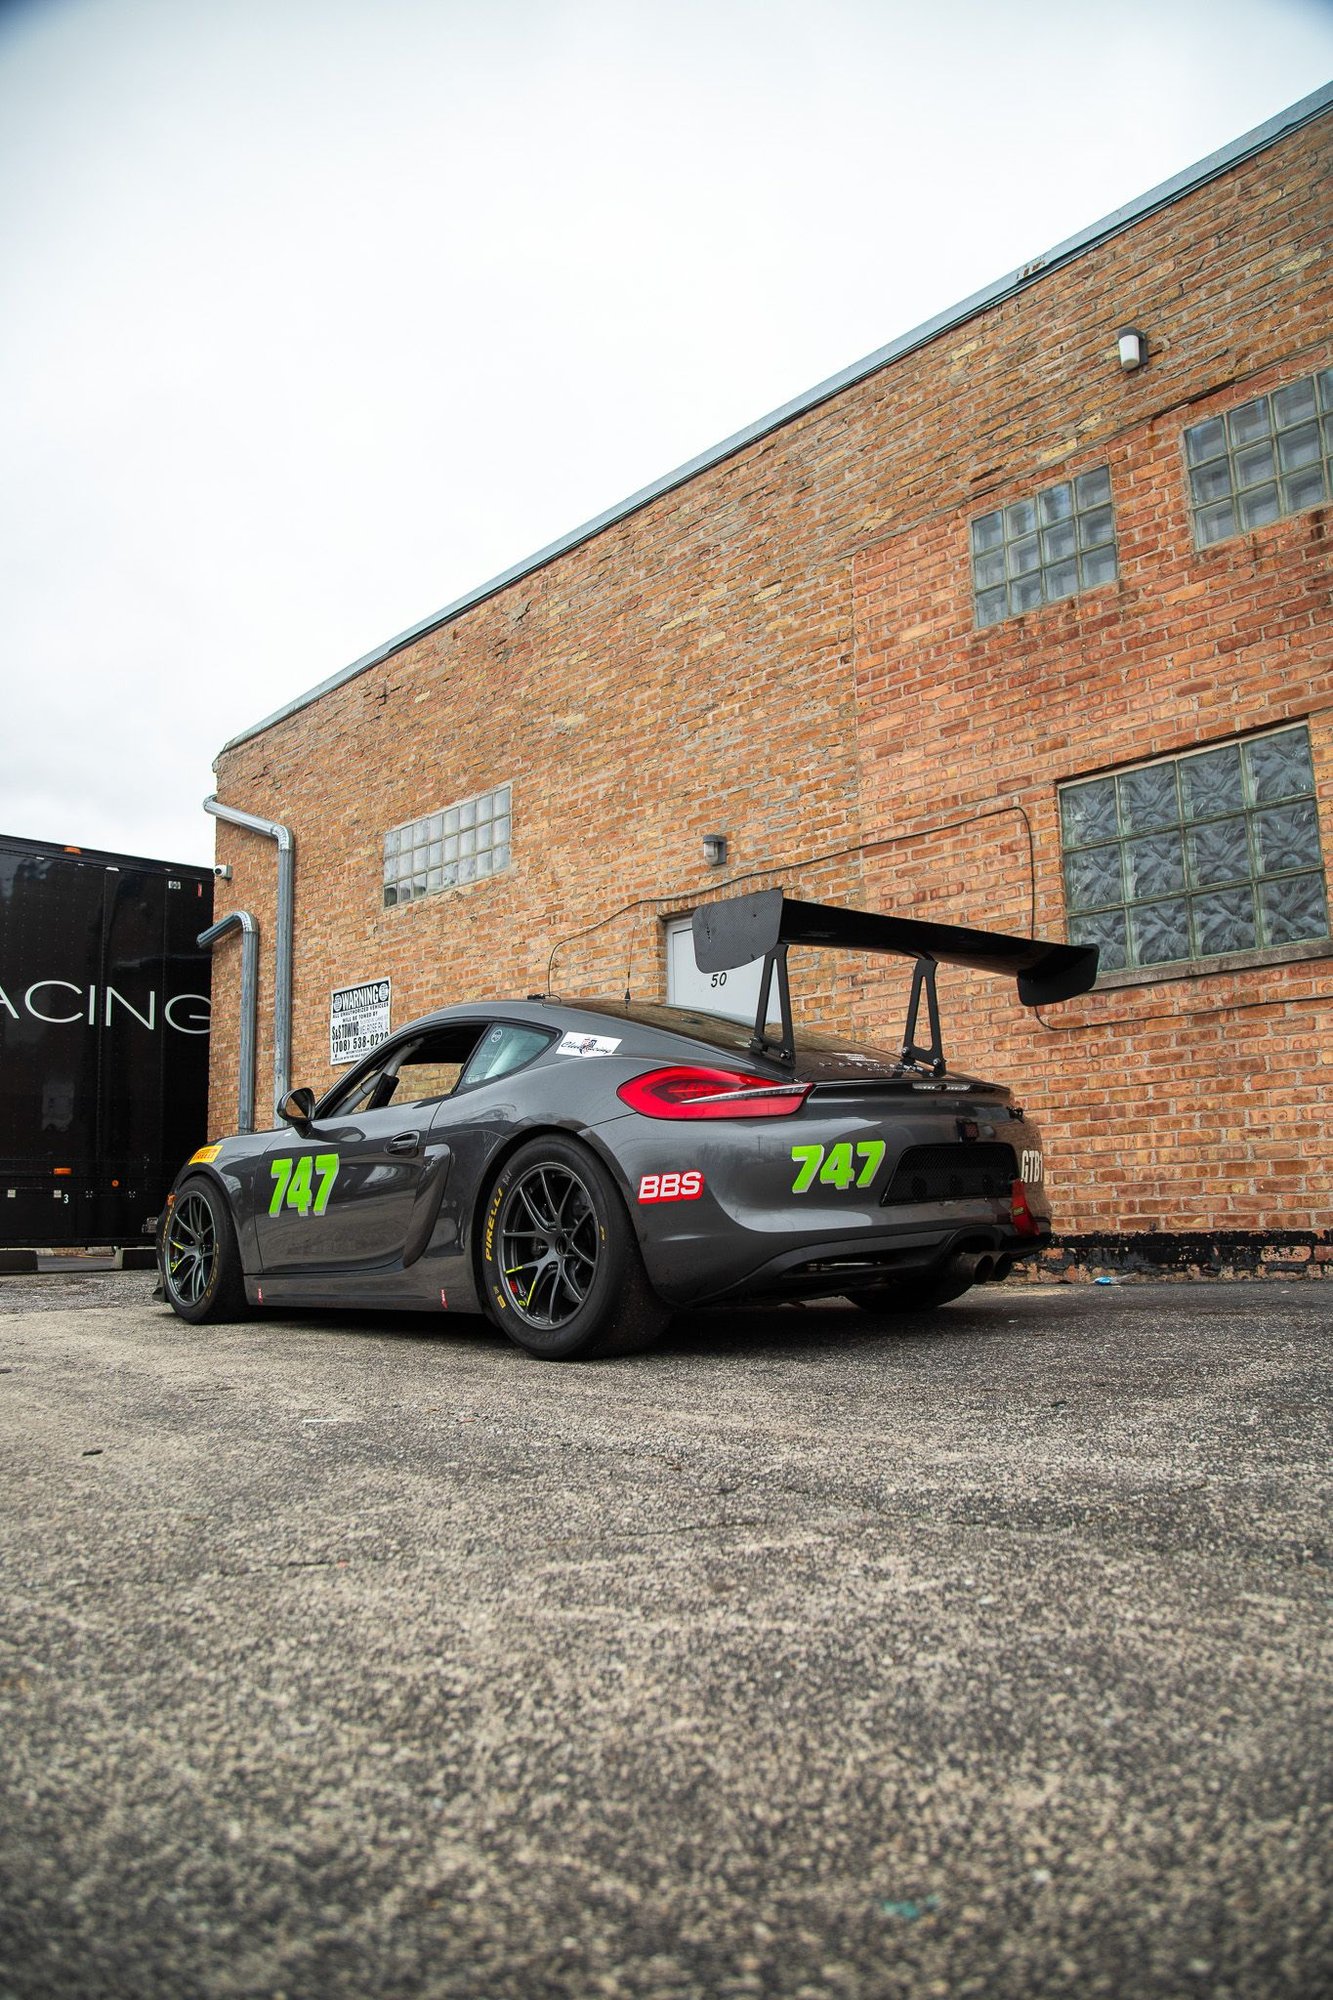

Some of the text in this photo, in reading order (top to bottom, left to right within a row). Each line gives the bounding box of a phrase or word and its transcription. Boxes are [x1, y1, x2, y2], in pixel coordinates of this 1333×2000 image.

[710, 972, 727, 988] 50
[342, 985, 379, 1010] WARNING
[341, 1006, 368, 1017] UNAUTHORIZED
[370, 1002, 388, 1010] VEHICLES
[341, 1021, 359, 1038] TOWING
[332, 1039, 350, 1053] (708)
[791, 1140, 886, 1194] 747
[268, 1153, 340, 1218] 747
[638, 1171, 702, 1200] BBS
[63, 1193, 69, 1204] 3
[485, 1187, 503, 1262] PIRELLI
